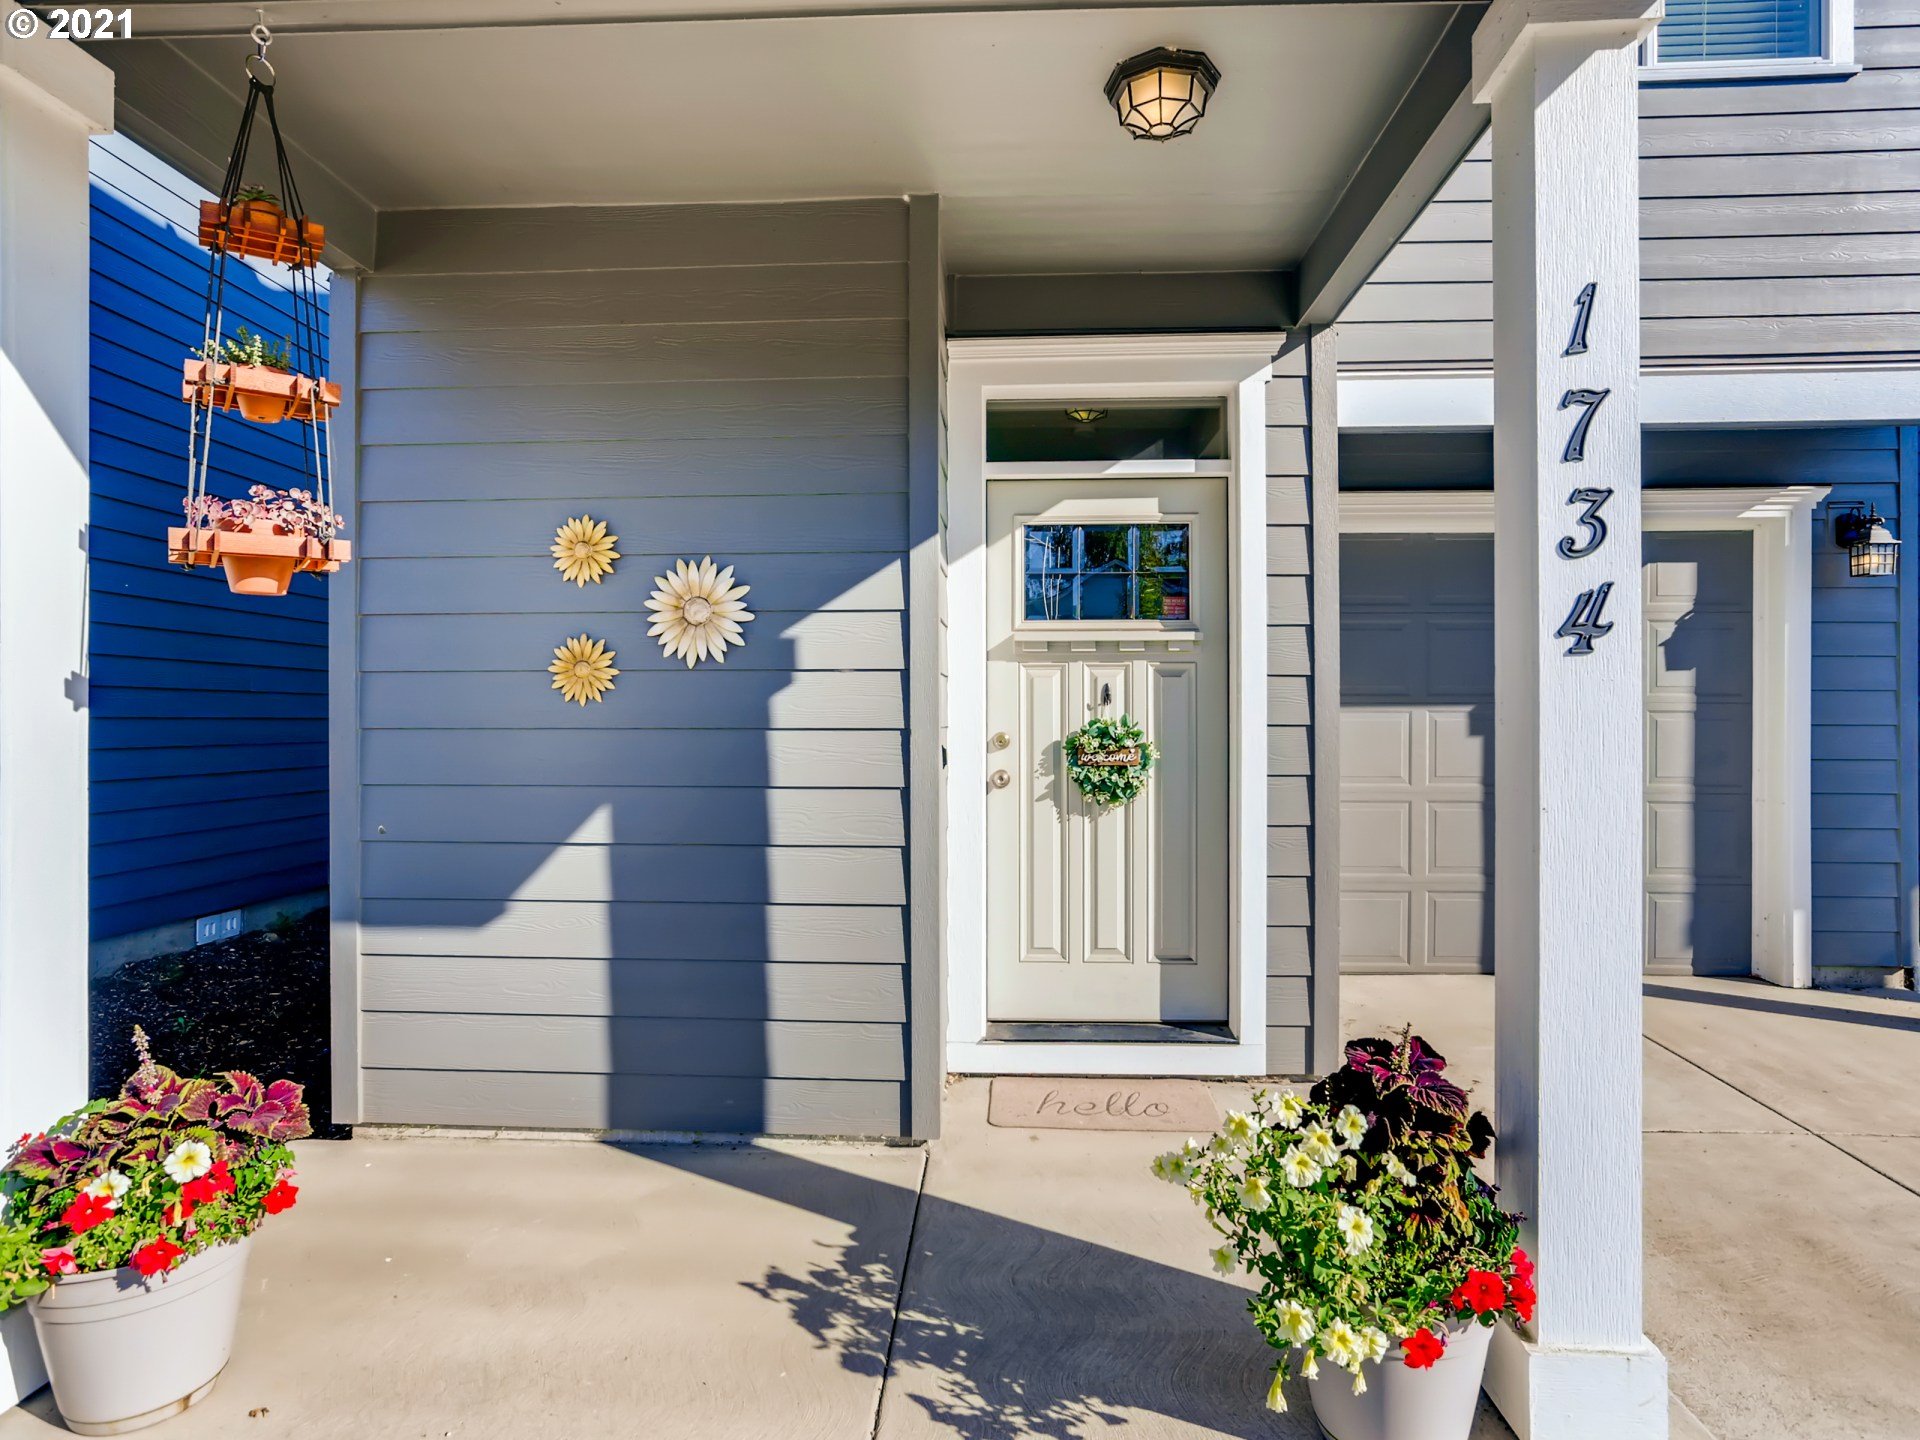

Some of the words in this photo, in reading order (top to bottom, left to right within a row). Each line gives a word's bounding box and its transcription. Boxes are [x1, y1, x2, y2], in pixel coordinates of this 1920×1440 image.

[1556, 281, 1615, 657] 1734
[1080, 752, 1137, 763] wecome
[1036, 1089, 1170, 1118] hello
